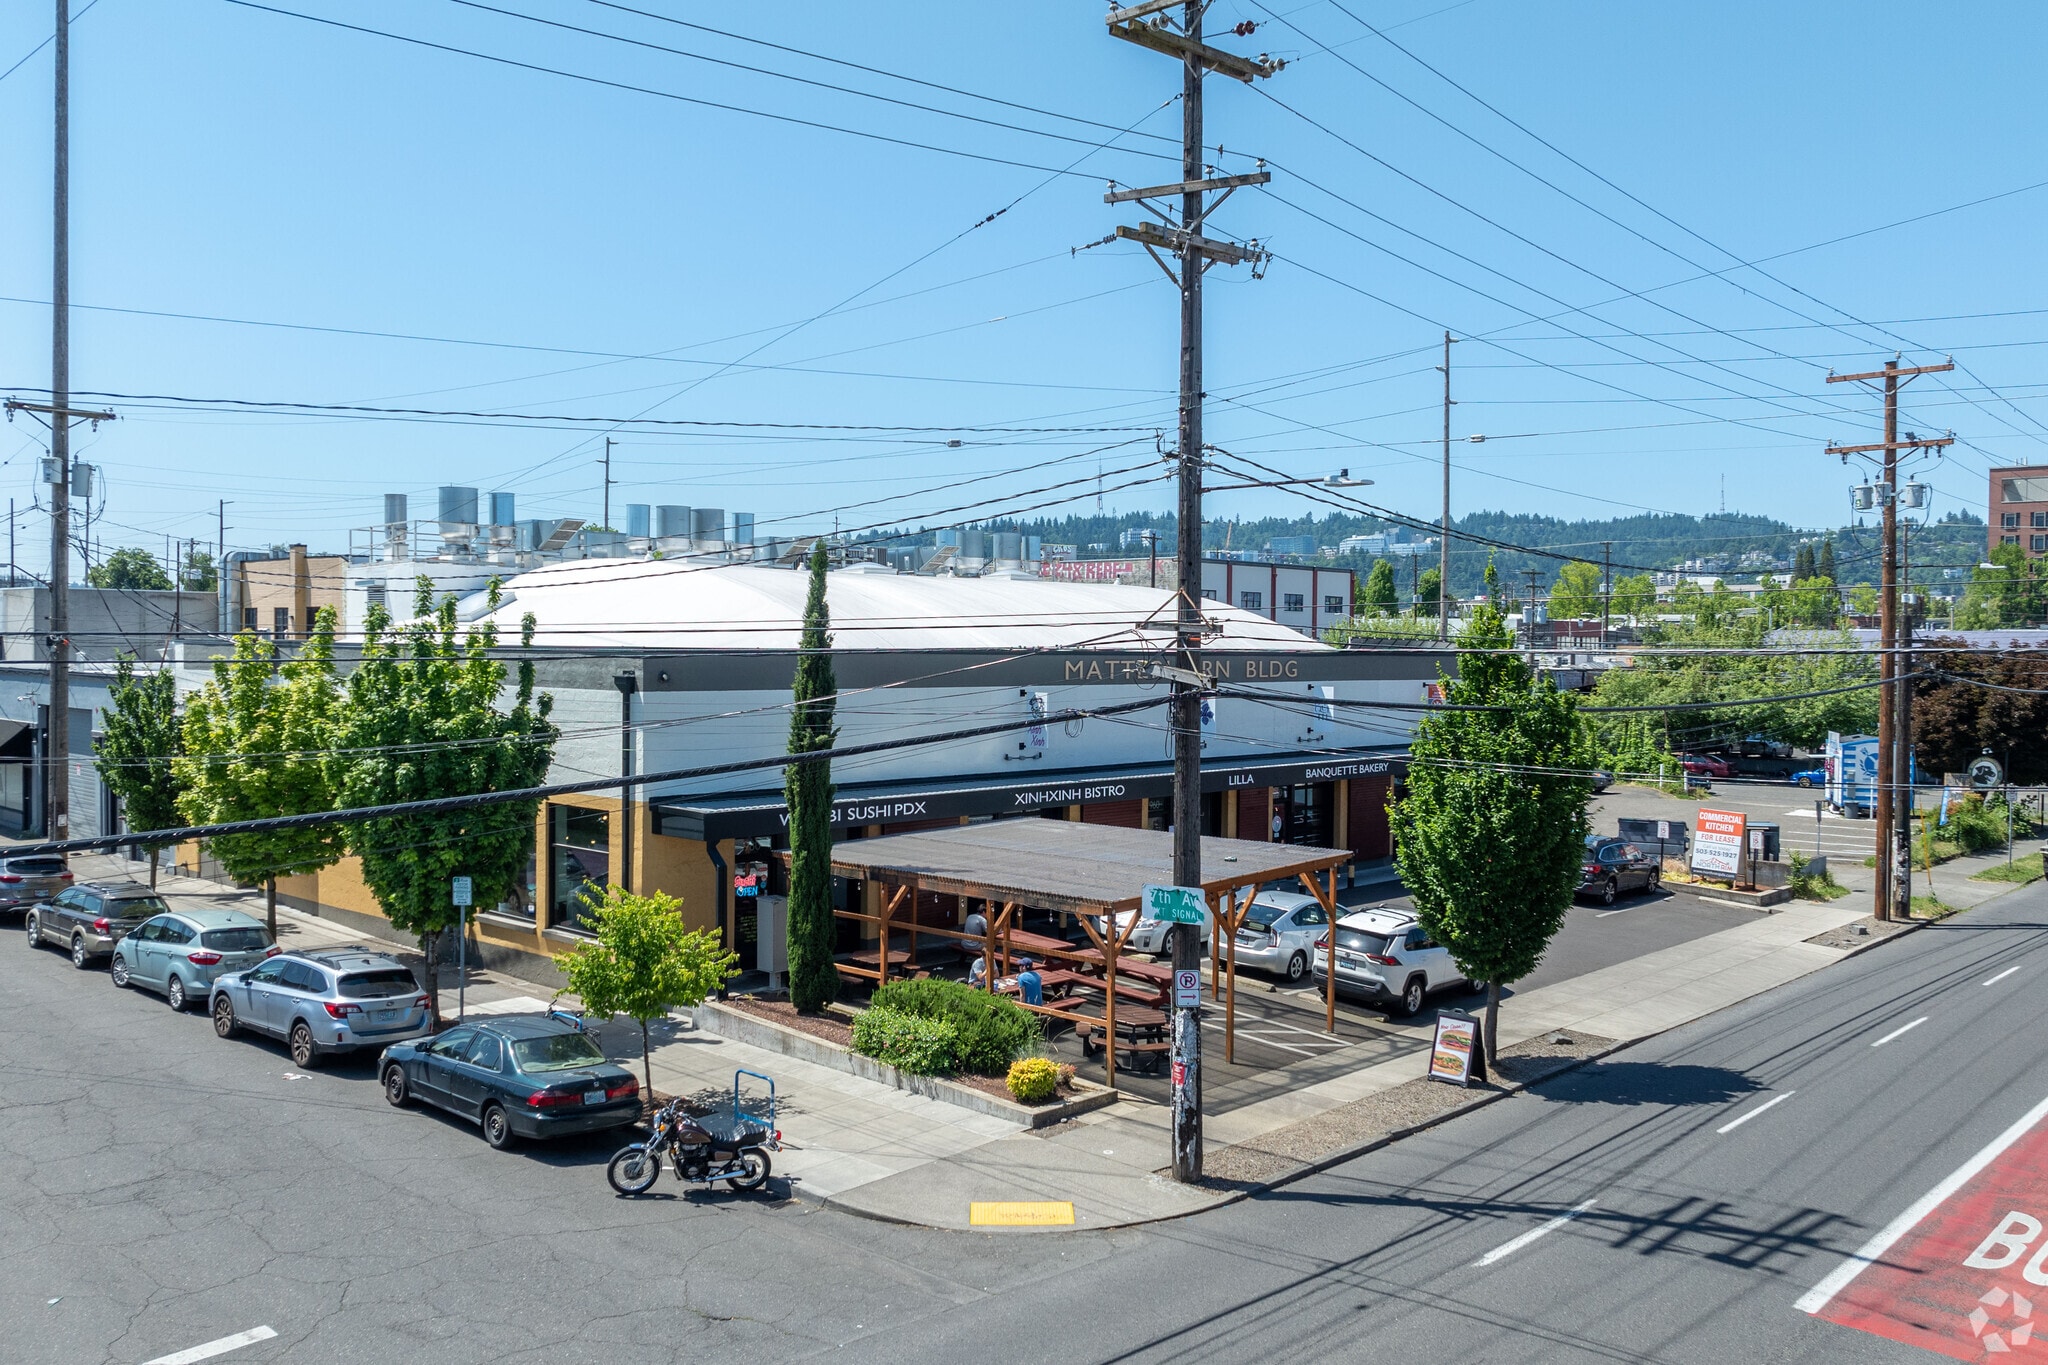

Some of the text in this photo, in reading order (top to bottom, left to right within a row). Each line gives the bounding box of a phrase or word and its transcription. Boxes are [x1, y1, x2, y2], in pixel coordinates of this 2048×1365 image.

[1246, 660, 1298, 678] BLDG
[1305, 762, 1389, 779] BANQUETTE BAKERY
[1228, 774, 1255, 786] LILLA
[1014, 785, 1125, 805] XINHXINH BISTRO
[847, 804, 891, 820] SUSHI
[894, 801, 926, 816] PDX
[1699, 812, 1743, 824] COMMERCIAL
[1705, 821, 1734, 832] KITCHEN
[1701, 833, 1736, 843] FOR LEASE
[736, 885, 759, 897] OPEN
[1172, 908, 1200, 920] SIGNAL
